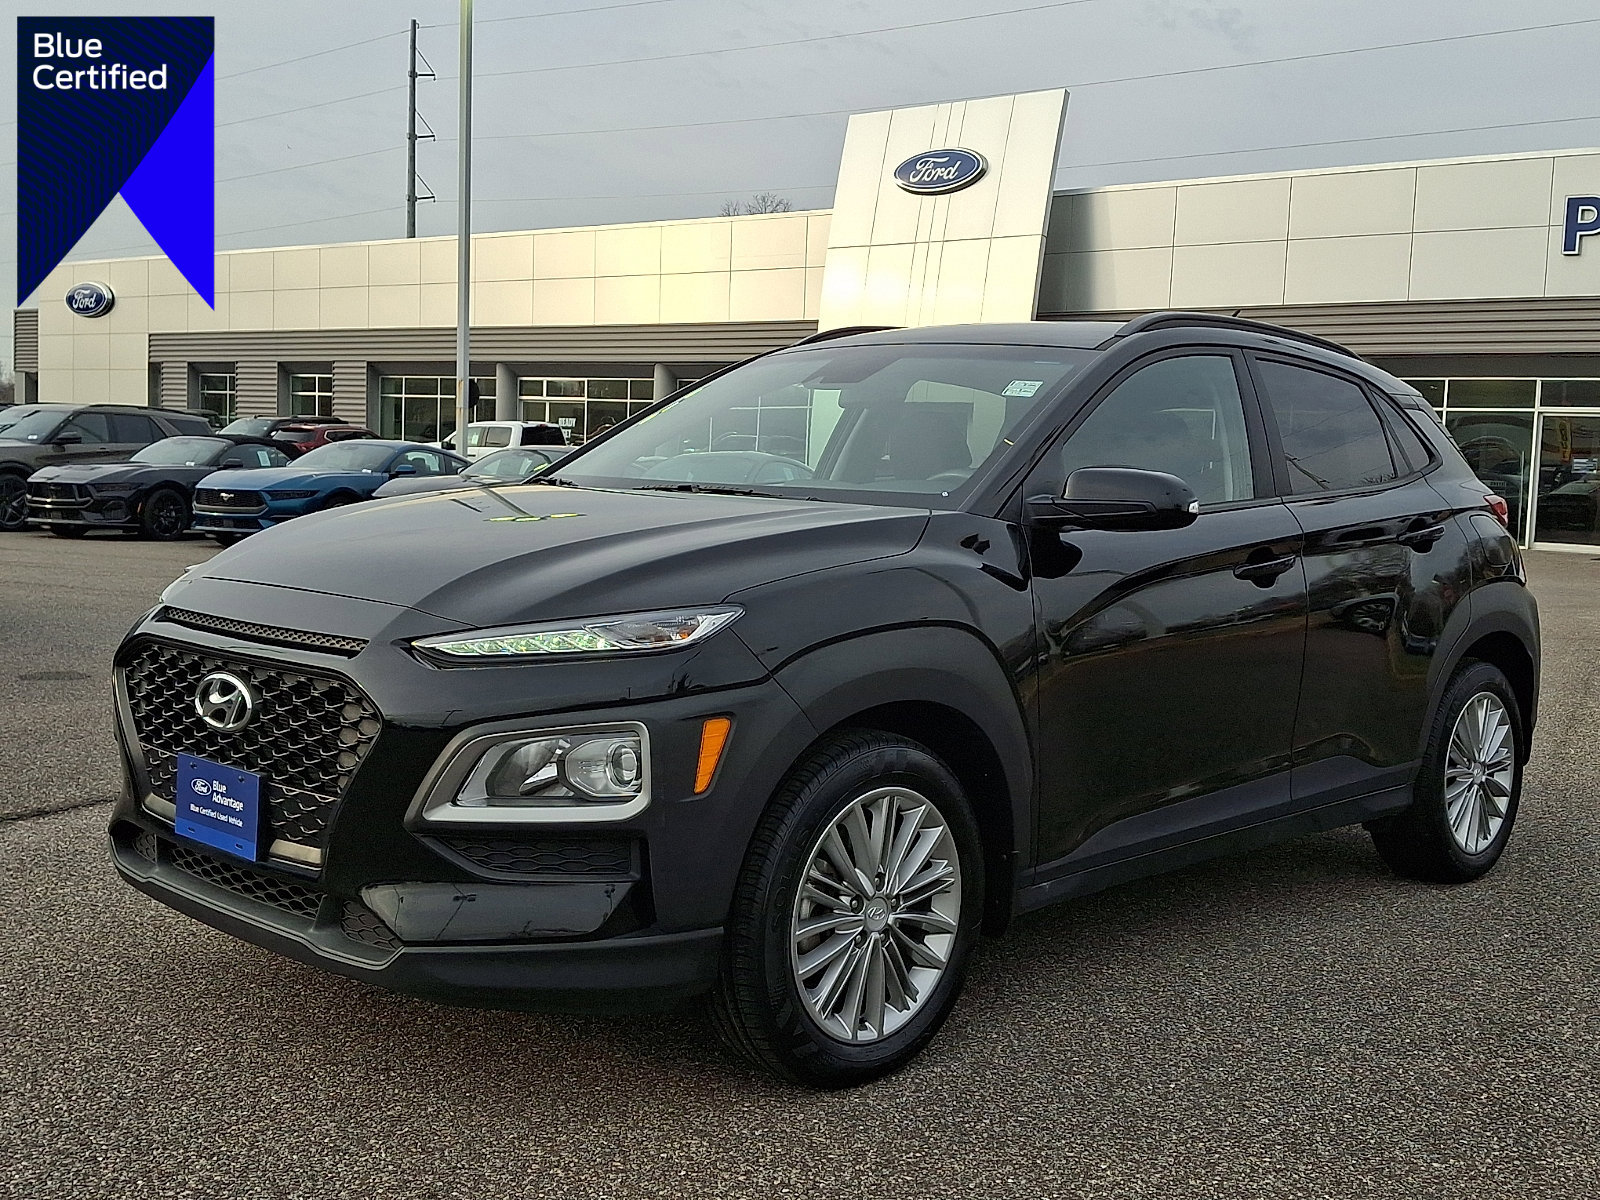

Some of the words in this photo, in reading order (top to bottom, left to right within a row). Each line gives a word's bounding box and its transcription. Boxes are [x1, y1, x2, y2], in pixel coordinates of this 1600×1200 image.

[909, 156, 962, 184] Ford
[1561, 194, 1600, 256] P
[72, 289, 97, 309] Ford
[212, 780, 227, 793] Blue
[212, 792, 243, 811] Advantage
[190, 803, 199, 812] Blue
[200, 807, 216, 819] Certified
[217, 811, 229, 823] Used
[229, 815, 243, 828] Vehicle
